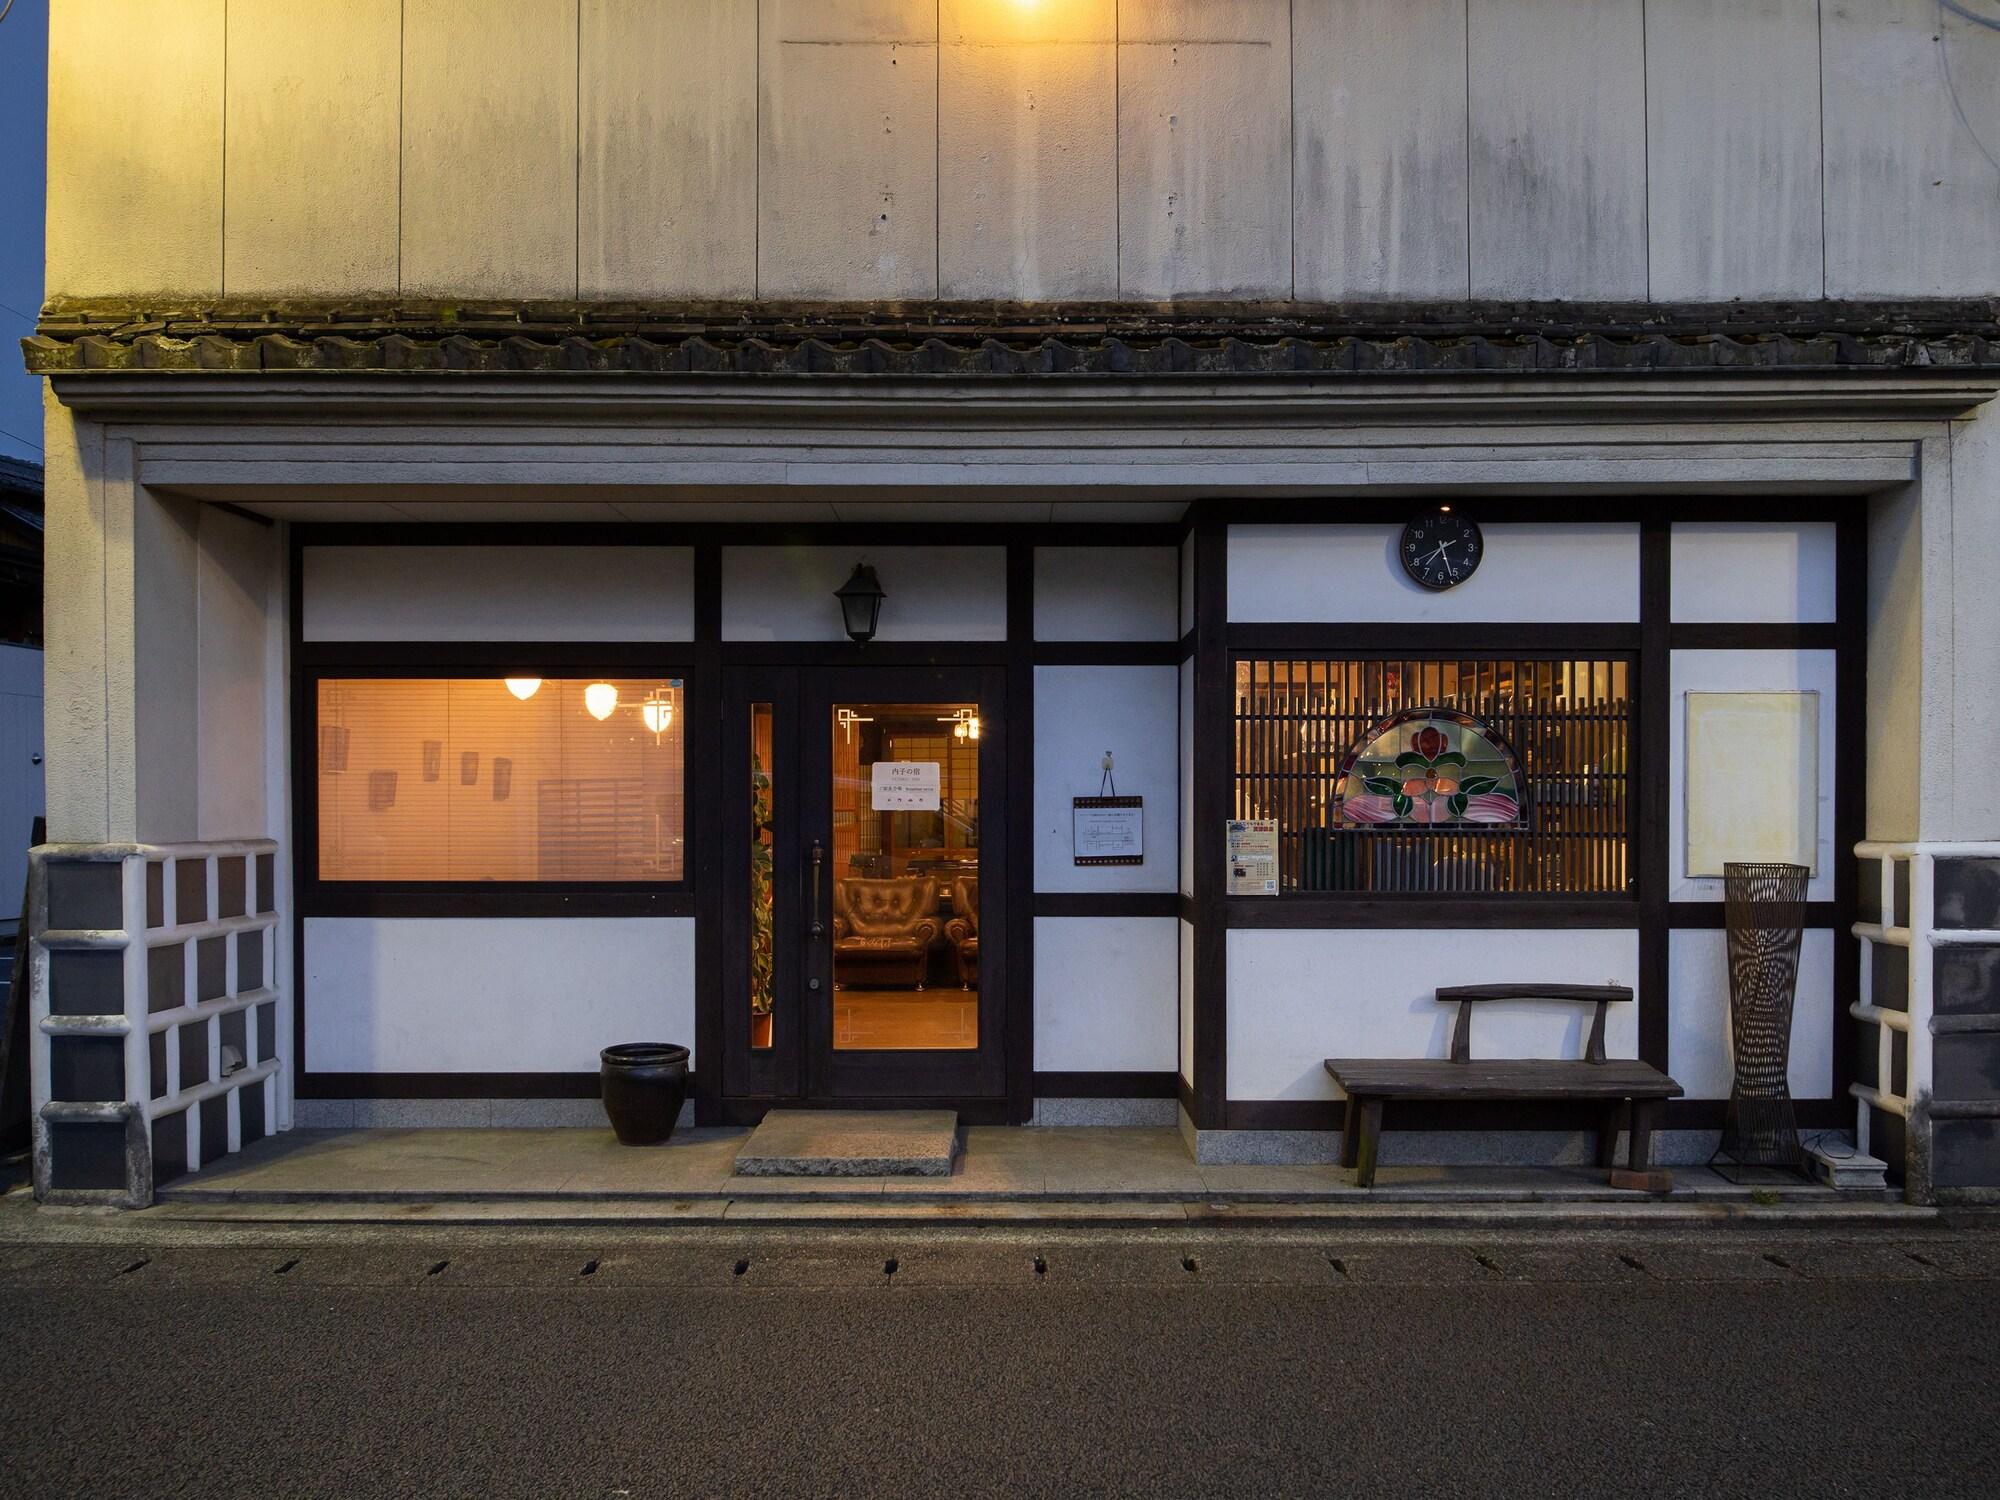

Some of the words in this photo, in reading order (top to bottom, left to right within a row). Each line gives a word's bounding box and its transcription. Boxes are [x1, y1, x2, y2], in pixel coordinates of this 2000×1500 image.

[1426, 520, 1433, 528] 11
[1415, 530, 1424, 539] 10
[1463, 529, 1470, 538] 2
[1409, 543, 1416, 552] 9
[1468, 543, 1474, 552] 3
[1414, 558, 1420, 566] 8
[1463, 558, 1468, 566] 4
[1424, 568, 1430, 576] 7
[1438, 571, 1444, 580] 6
[1453, 568, 1458, 576] 5
